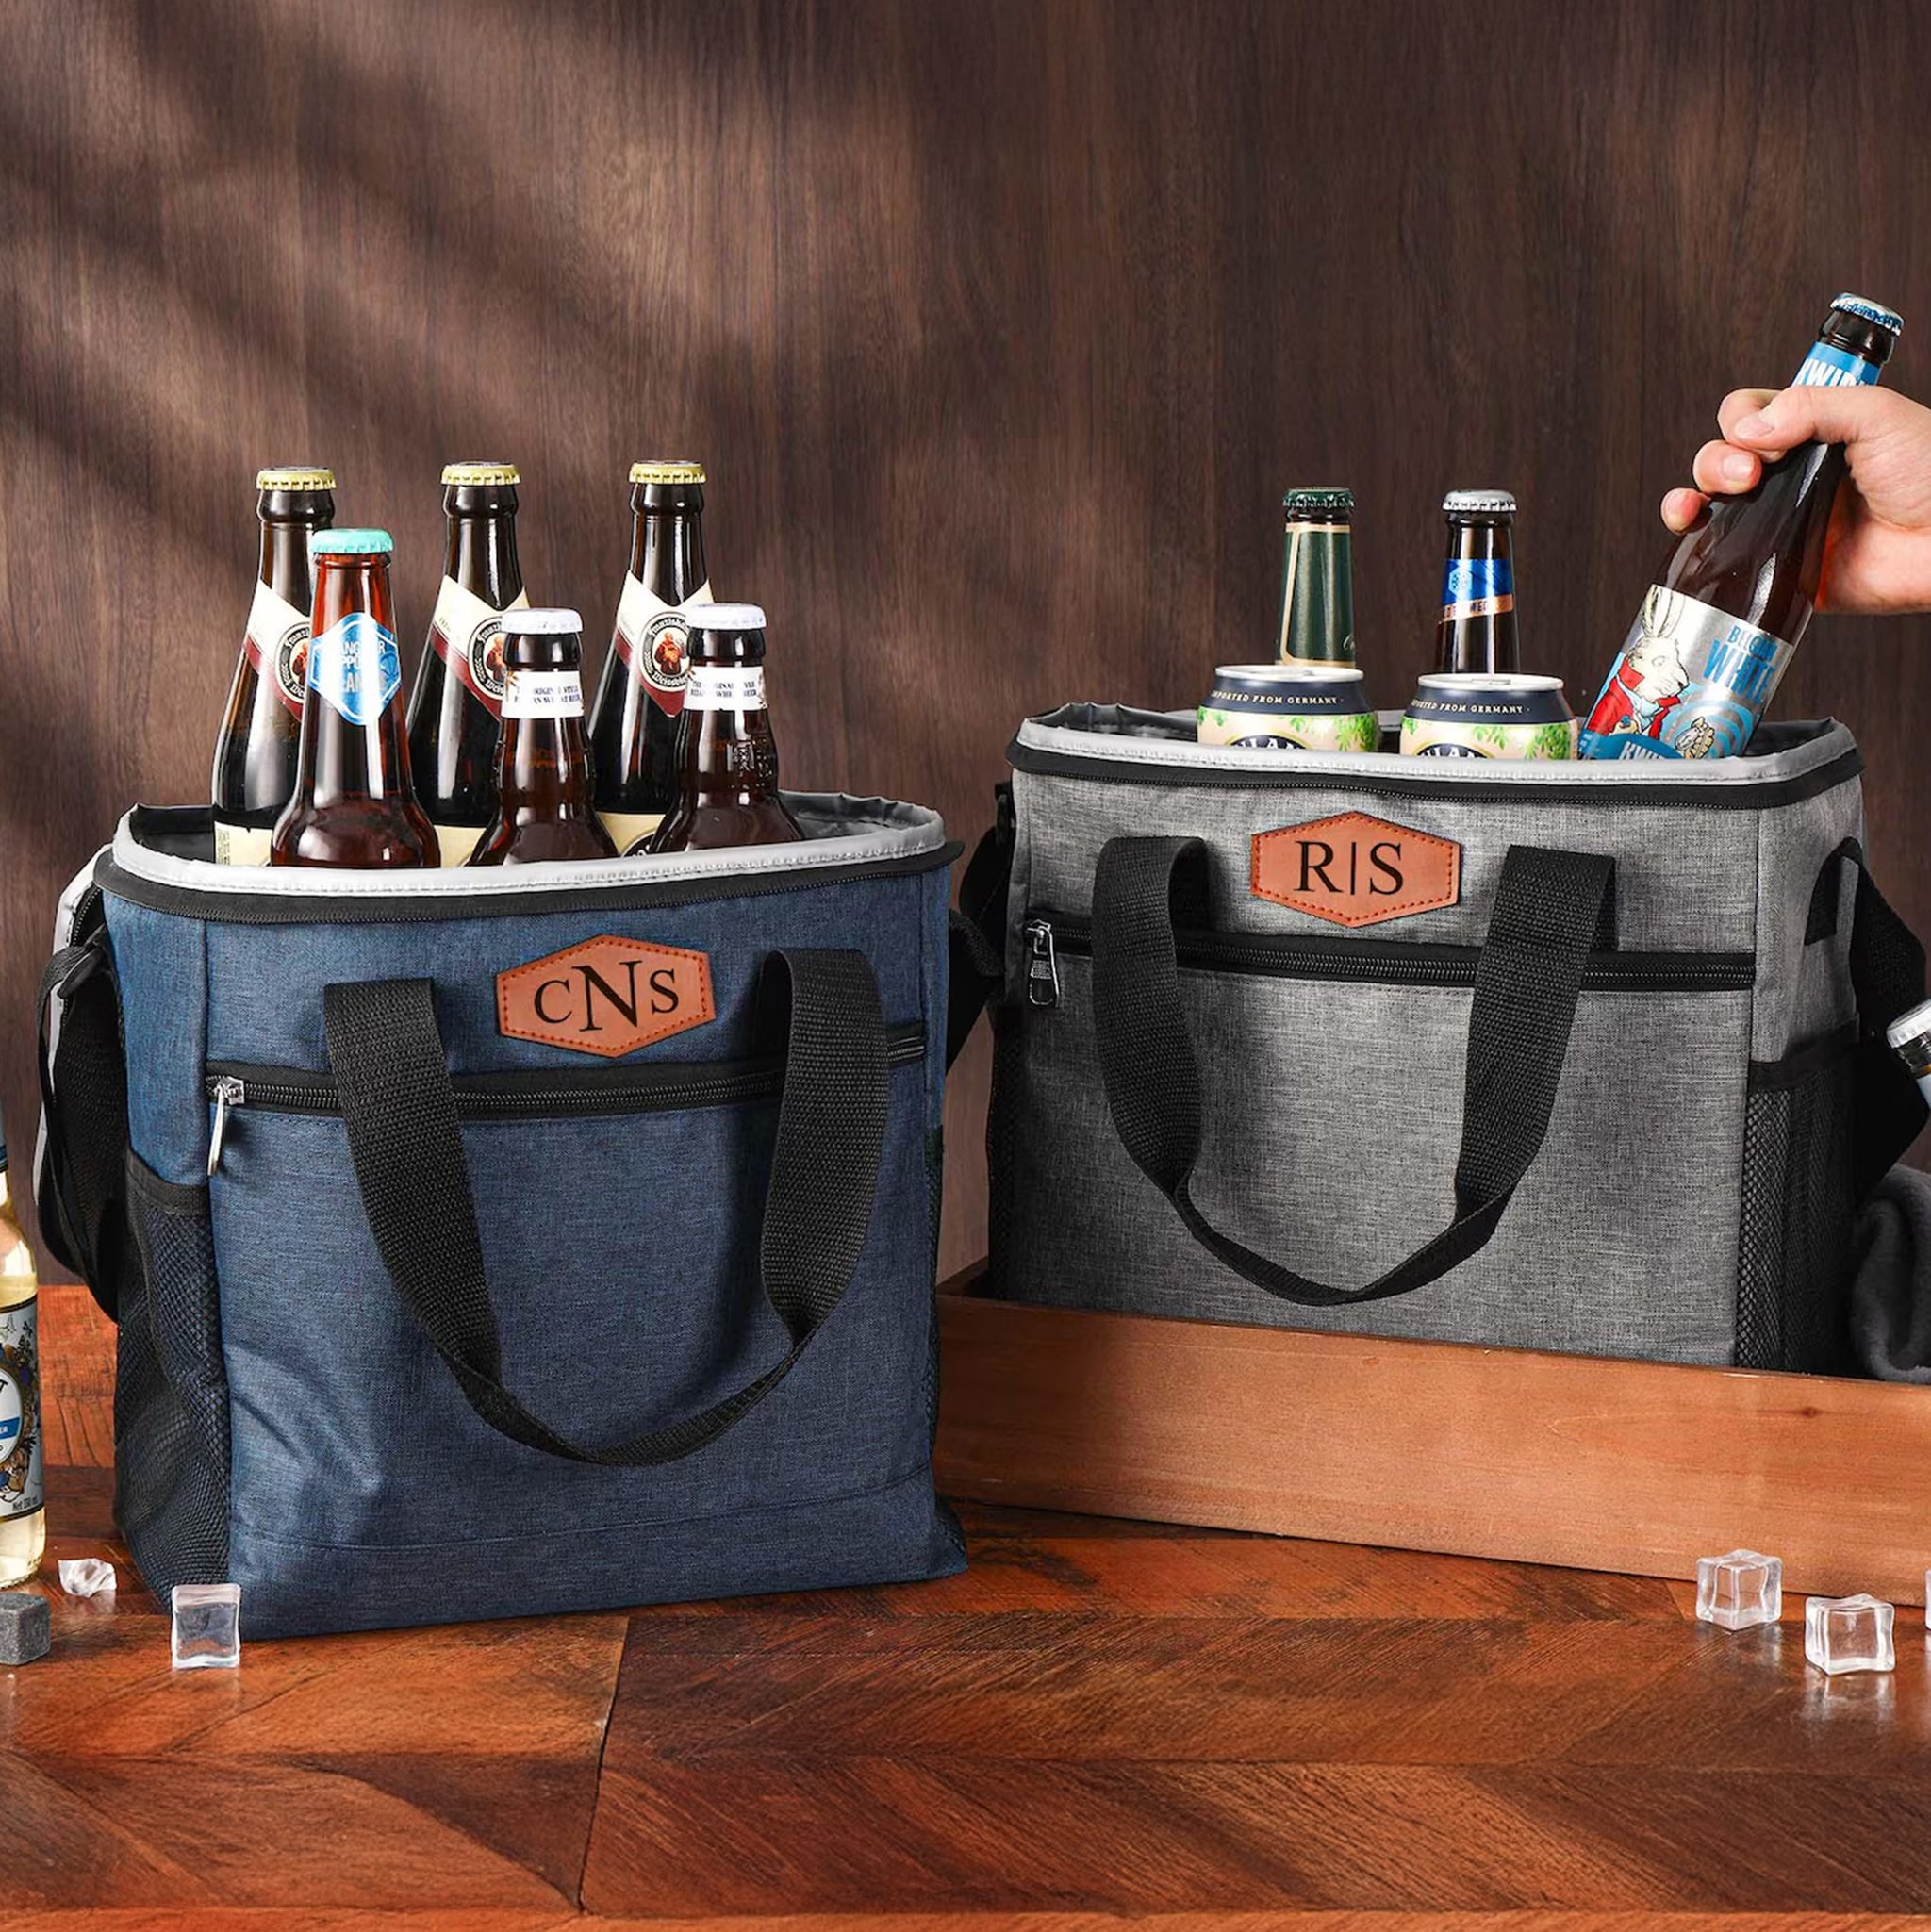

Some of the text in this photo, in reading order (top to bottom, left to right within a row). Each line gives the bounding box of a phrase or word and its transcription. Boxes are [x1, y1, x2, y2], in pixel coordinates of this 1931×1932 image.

[1704, 638, 1776, 704] WHITE
[1252, 695, 1283, 704] FROM
[1439, 703, 1467, 713] FROM
